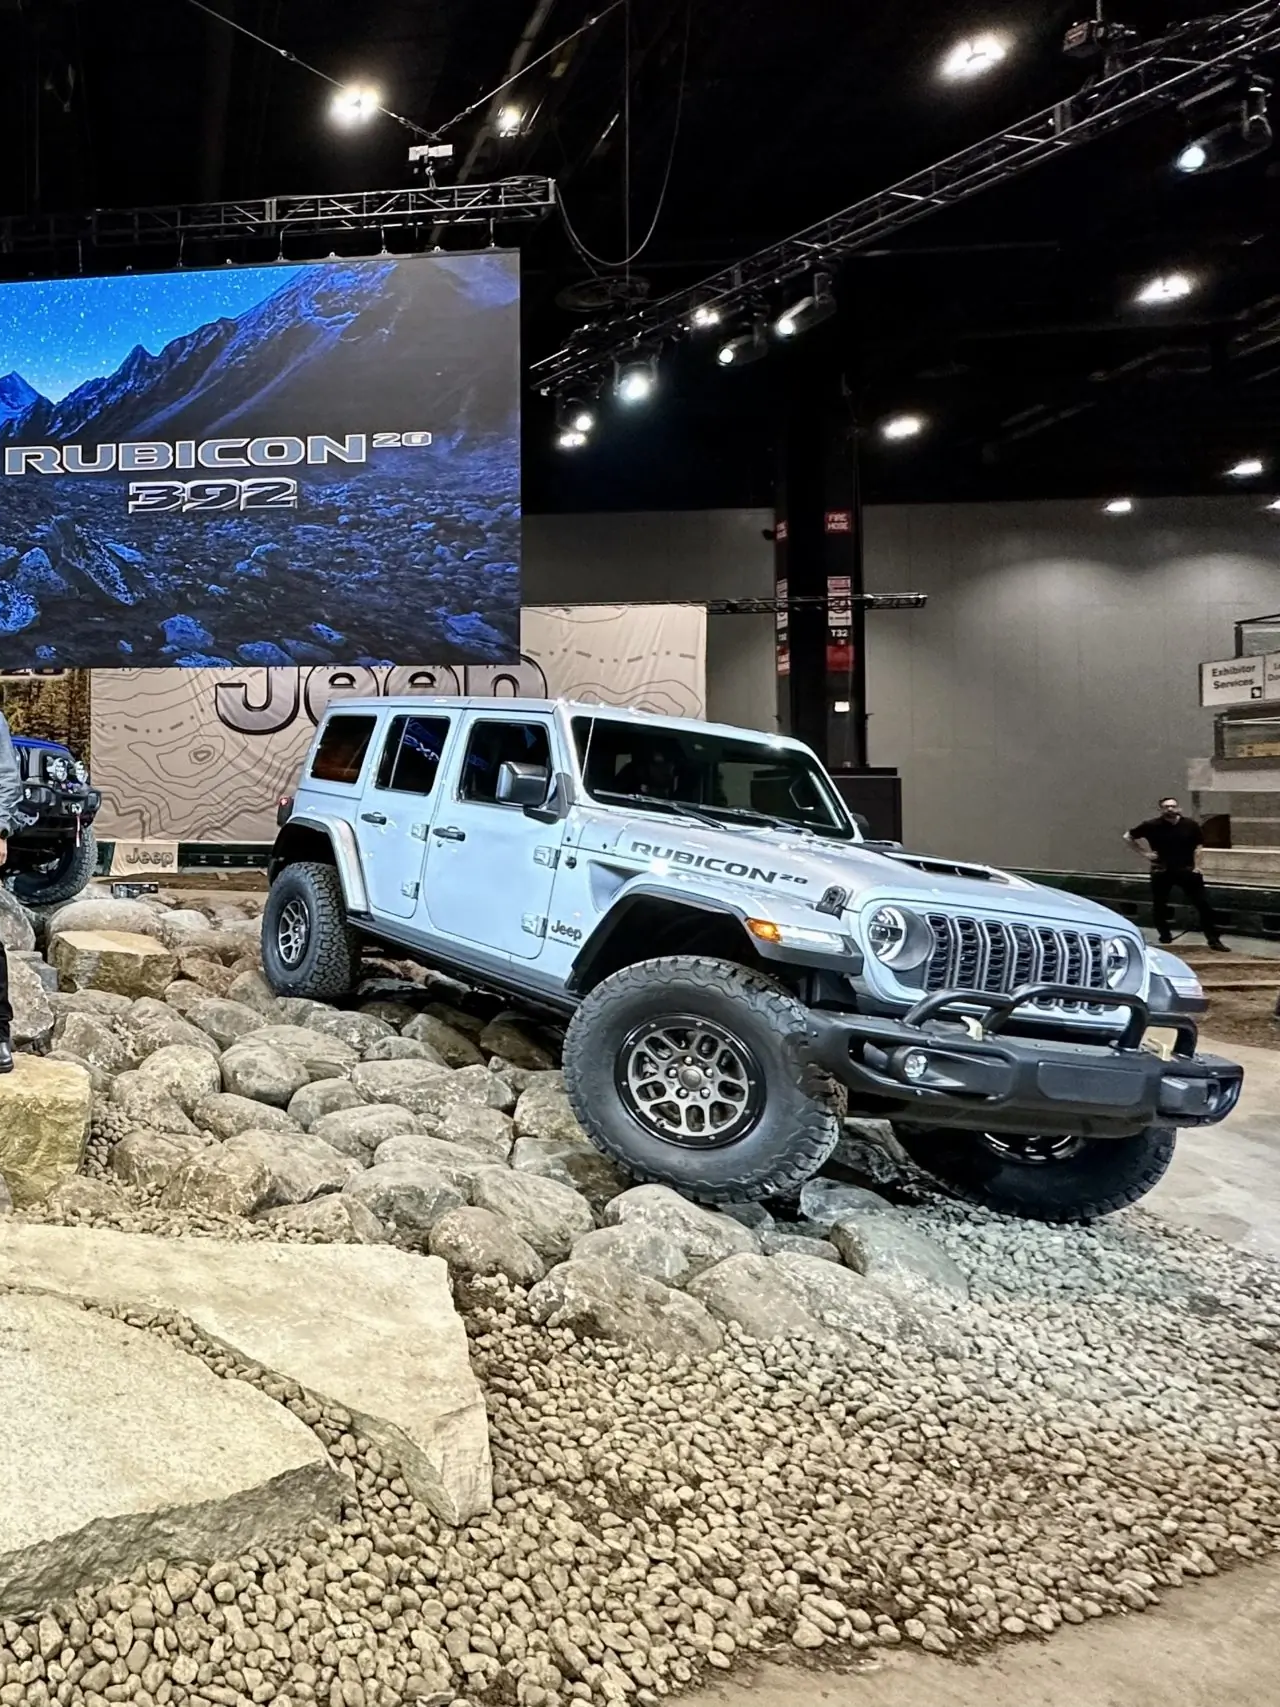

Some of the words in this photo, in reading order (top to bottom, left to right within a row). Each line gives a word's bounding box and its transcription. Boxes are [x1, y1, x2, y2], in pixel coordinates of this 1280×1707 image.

[5, 433, 366, 475] RUBICON
[128, 477, 297, 514] 392
[830, 629, 848, 638] T32
[1211, 664, 1256, 678] Exhibitor
[1213, 677, 1255, 690] Services
[125, 847, 174, 868] Jeep
[631, 841, 777, 884] RUBICON
[551, 919, 582, 941] Jeep
